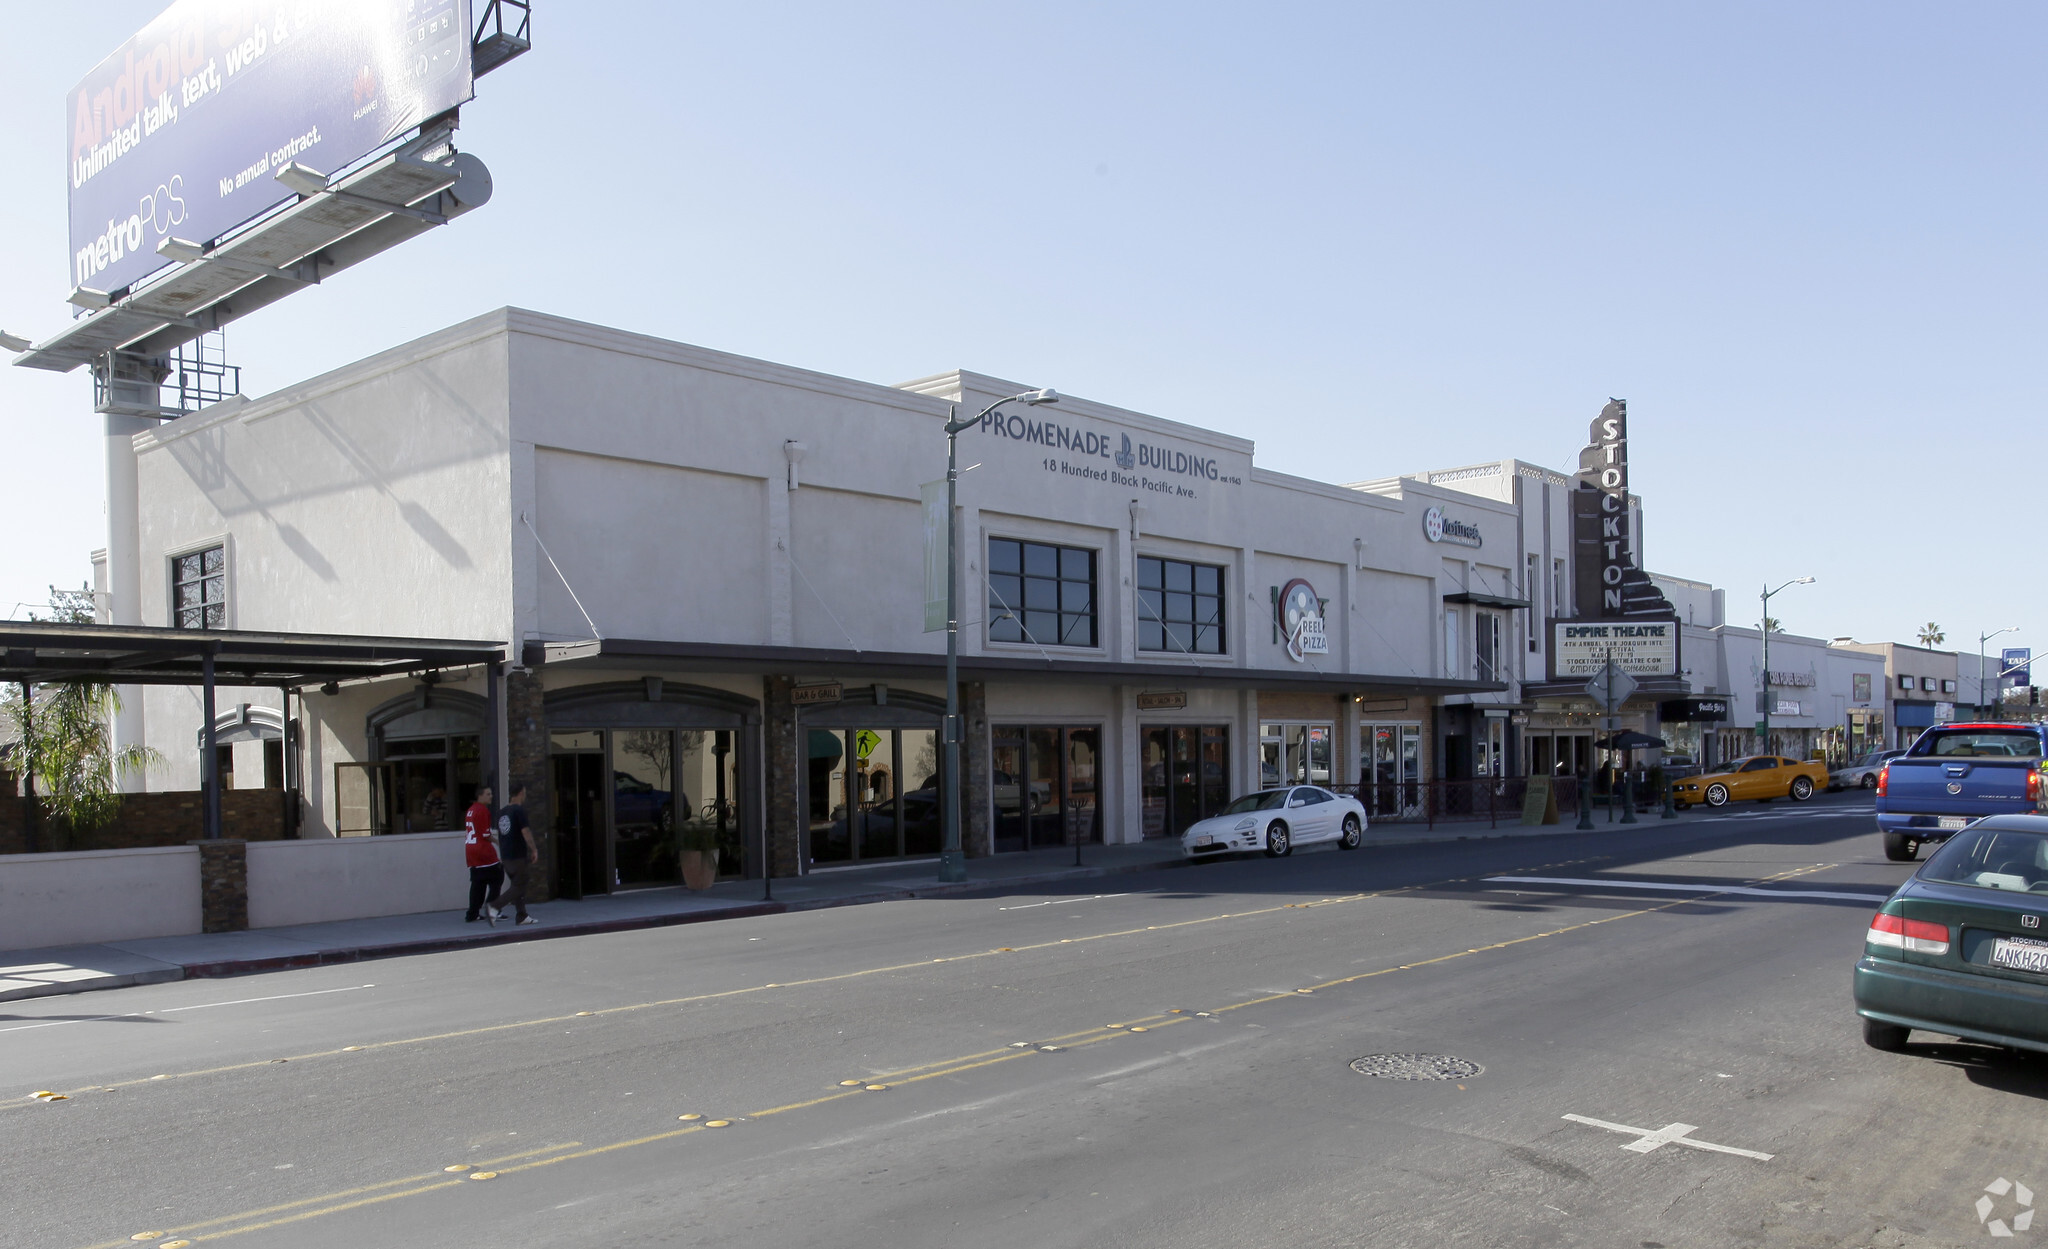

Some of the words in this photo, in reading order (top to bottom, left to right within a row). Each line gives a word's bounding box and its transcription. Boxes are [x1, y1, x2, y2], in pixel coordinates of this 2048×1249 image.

[73, 112, 141, 189] Unlimited
[143, 90, 178, 124] talk,
[181, 57, 222, 108] text,
[225, 23, 267, 77] web
[272, 5, 290, 45] &
[353, 99, 378, 121] HUAWEI
[219, 178, 234, 198] No
[235, 152, 269, 188] annual
[271, 125, 322, 167] contract.
[981, 409, 1110, 458] PROMENADE
[1139, 443, 1218, 480] BUILDING
[1043, 458, 1057, 472] 18
[1061, 461, 1107, 481] Hundred
[1112, 471, 1138, 488] Block
[1142, 477, 1173, 495] Pacific
[1176, 485, 1198, 499] Ave.
[1601, 419, 1622, 609] STOCKTON
[1302, 620, 1322, 634] REEL
[1566, 626, 1608, 638] EMPIRE
[1612, 626, 1665, 637] THEATRE
[1303, 636, 1327, 649] PIZZA
[794, 690, 810, 700] BAR
[810, 690, 816, 699] &
[818, 689, 837, 698] GRILL
[2010, 936, 2048, 947] STOCKTON
